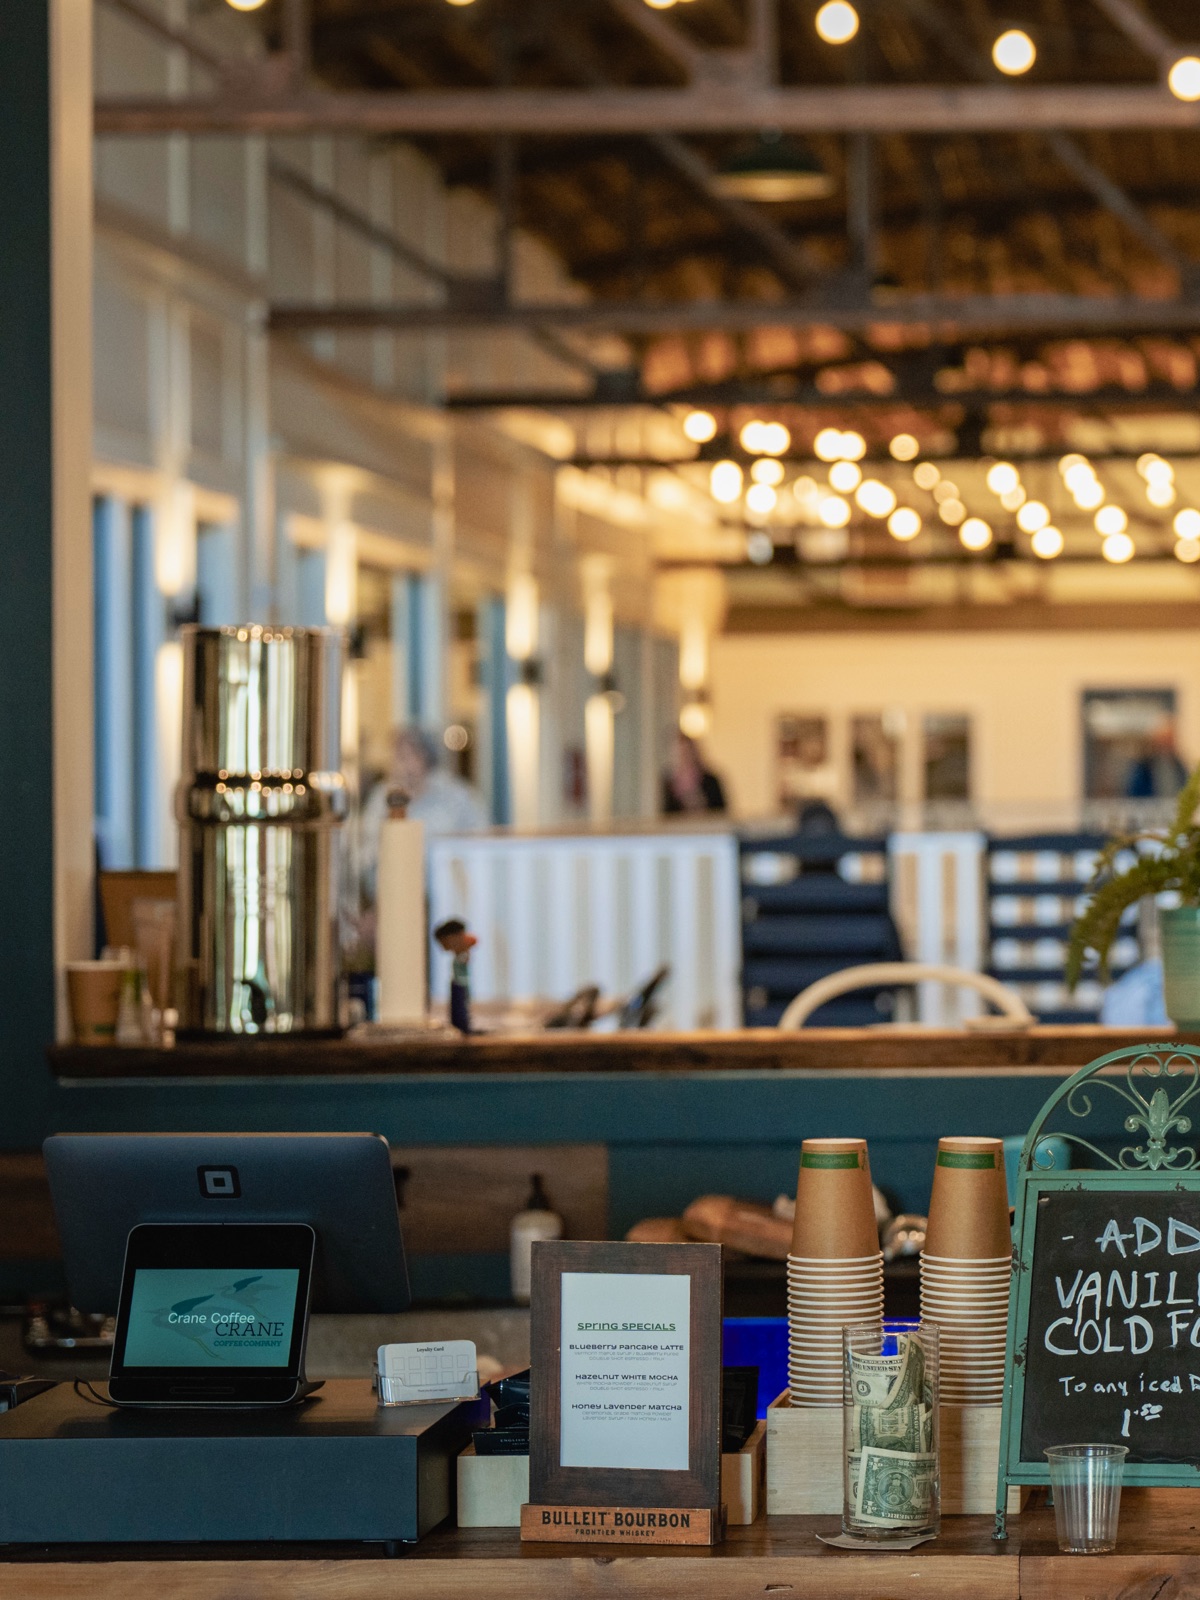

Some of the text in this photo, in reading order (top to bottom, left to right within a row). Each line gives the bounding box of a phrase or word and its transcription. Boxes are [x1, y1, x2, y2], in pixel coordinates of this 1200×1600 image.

[168, 1313, 255, 1324] Crane Coffee
[215, 1322, 284, 1336] CRANE
[622, 1323, 676, 1331] SPECIALS
[1045, 1316, 1154, 1355] COLD
[1059, 1376, 1087, 1396] To
[1094, 1381, 1128, 1396] any
[1139, 1372, 1183, 1394] iced
[542, 1511, 690, 1528] BULLEIT BOURBON
